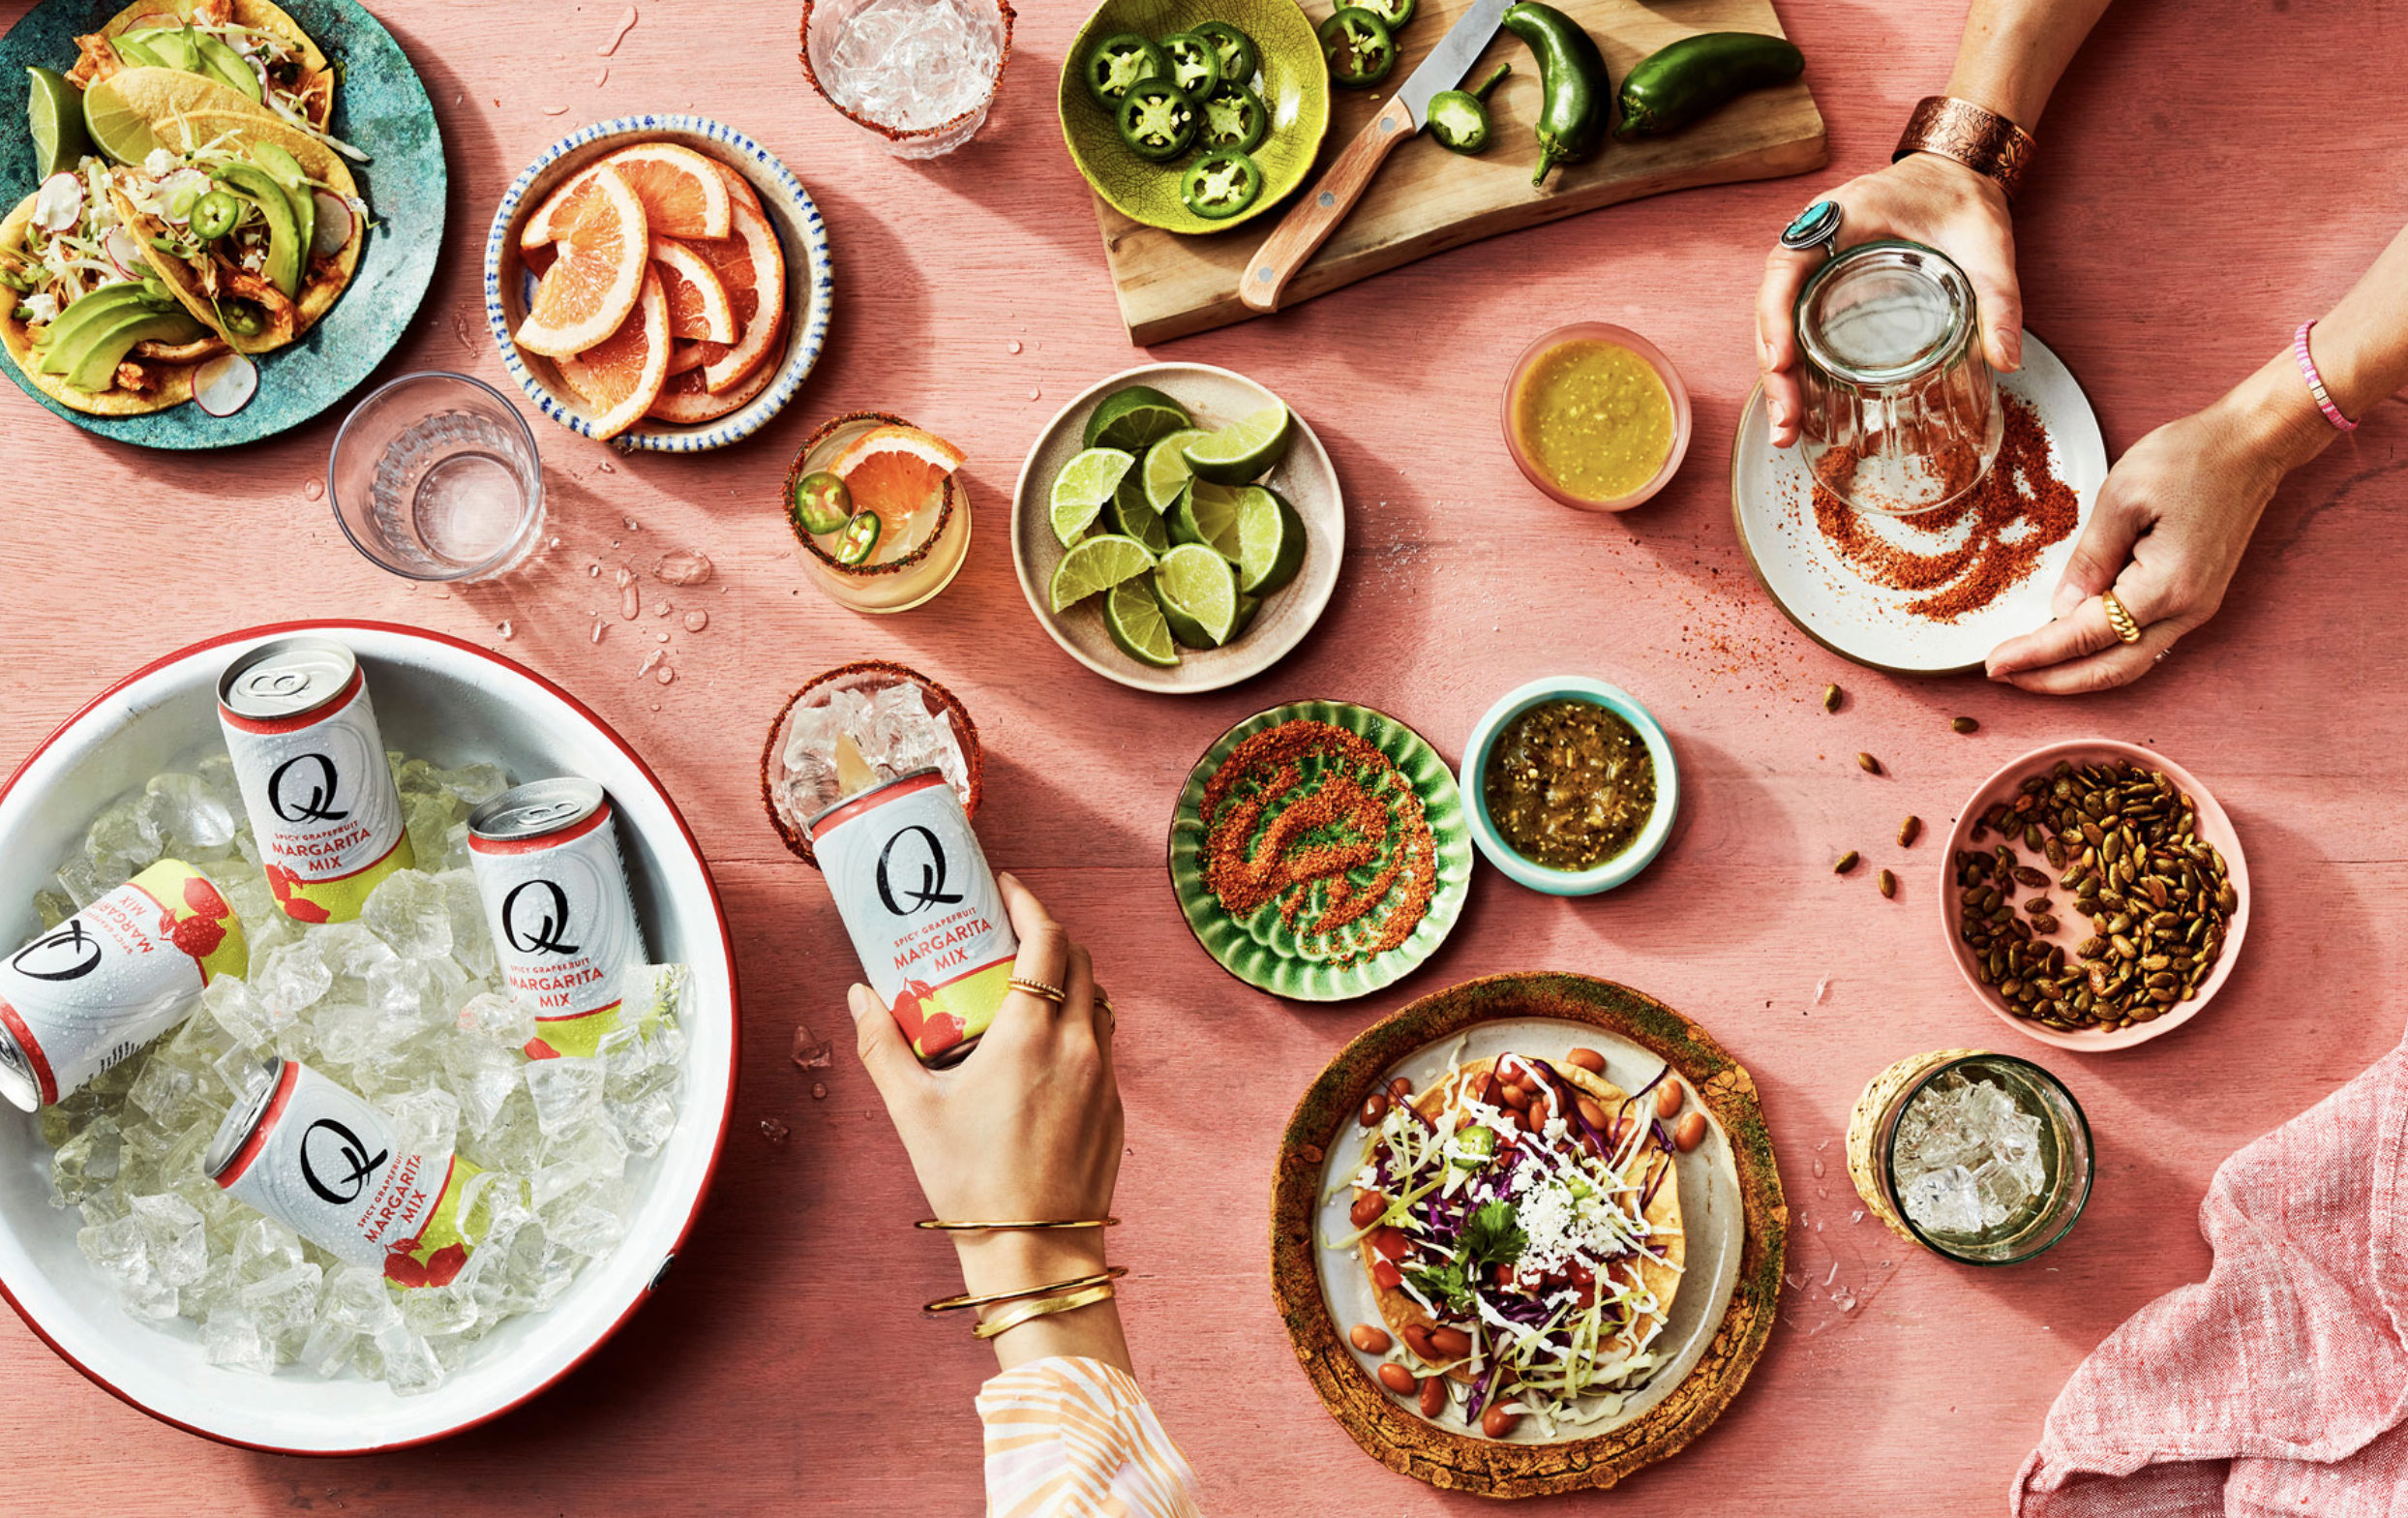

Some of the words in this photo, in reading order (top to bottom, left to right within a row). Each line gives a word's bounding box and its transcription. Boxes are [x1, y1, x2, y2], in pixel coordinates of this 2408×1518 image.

[268, 753, 348, 824] Q
[272, 827, 372, 856] MARGARITA
[275, 833, 299, 841] SPICY
[302, 820, 358, 841] GRAPEFRUIT
[309, 855, 343, 871] MIX
[877, 825, 963, 916] Q
[118, 896, 147, 917] MIX
[502, 879, 580, 956] Q
[894, 930, 918, 948] SPICY
[921, 907, 977, 934] GRAPEFRUIT
[112, 933, 133, 955] SPICY
[893, 918, 992, 970] MARGARITA
[511, 964, 529, 973] SPICY
[533, 956, 589, 974] GRAPEFRUIT
[934, 946, 969, 972] MIX
[509, 966, 604, 990] MARGARITA
[539, 992, 572, 1008] MIX
[300, 1118, 387, 1204] Q
[364, 1154, 422, 1243] MARGARITA
[401, 1189, 427, 1224] MIX
[358, 1204, 376, 1228] SPICY
